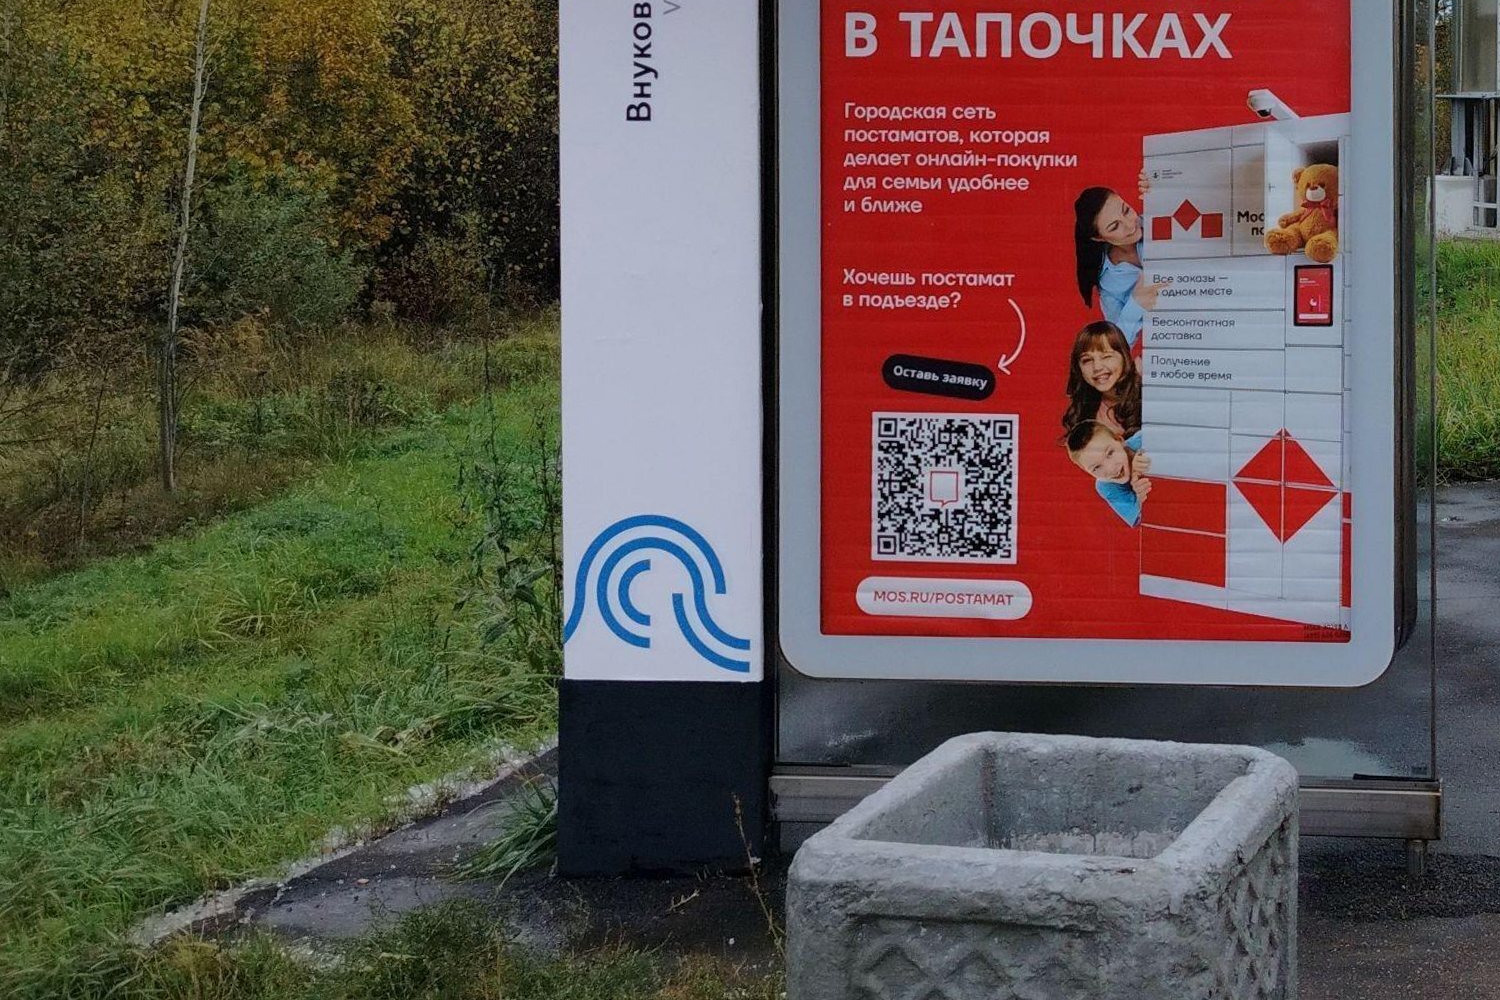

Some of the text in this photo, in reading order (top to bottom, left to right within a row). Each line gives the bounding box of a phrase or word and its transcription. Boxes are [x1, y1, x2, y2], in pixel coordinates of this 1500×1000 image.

[844, 12, 1234, 59] В ТАПОЧКАХ
[844, 102, 997, 121] Городская сеть
[844, 129, 1050, 146] постаматов, которая
[843, 150, 1078, 170] делает онлайн-покупки
[843, 174, 1030, 193] для семьи удобнее
[844, 196, 923, 213] и ближе
[842, 268, 1016, 287] Хочешь постамат
[1152, 274, 1174, 284] Все
[1177, 275, 1216, 283] заказы
[843, 291, 962, 310] в подъезде?
[1161, 289, 1197, 297] одном
[1199, 288, 1233, 296] месте
[1152, 317, 1236, 327] Бесконтактная
[1151, 332, 1203, 341] доставка
[1151, 355, 1211, 367] Получение
[893, 365, 988, 390] Оставь заявку
[1160, 369, 1195, 379] любое
[1198, 372, 1232, 381] время
[873, 590, 1015, 606] MOS.RU/POSTAMAT
